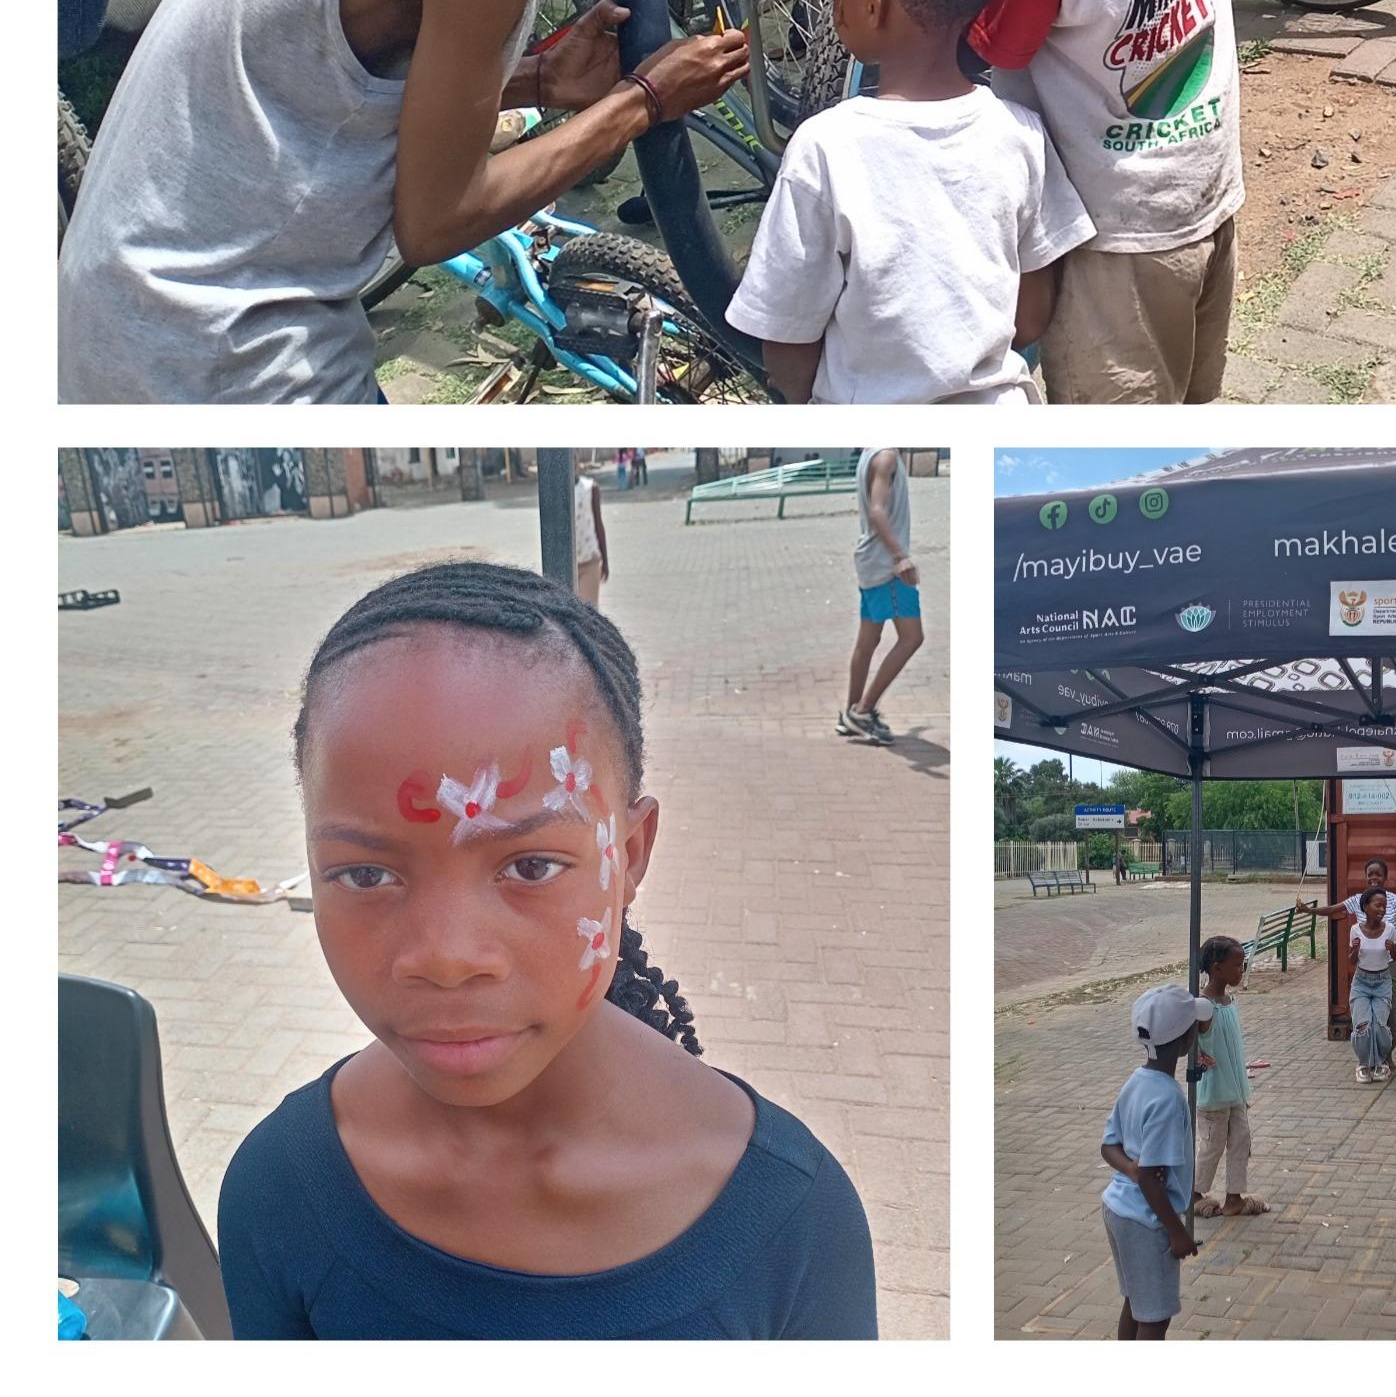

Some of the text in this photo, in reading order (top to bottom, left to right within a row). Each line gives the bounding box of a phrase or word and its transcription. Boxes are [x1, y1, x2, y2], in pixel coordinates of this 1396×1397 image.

[1105, 98, 1222, 140] CRICKET
[1103, 118, 1222, 153] SOUTH AFRICA
[1013, 543, 1202, 582] /mayibuy_vae
[1243, 599, 1312, 608] PRESIDENTIAL
[1036, 610, 1079, 623] National
[1243, 609, 1310, 618] EMPLOYMENT
[1020, 622, 1079, 635] Arts Council
[1242, 619, 1290, 628] STIMULUS
